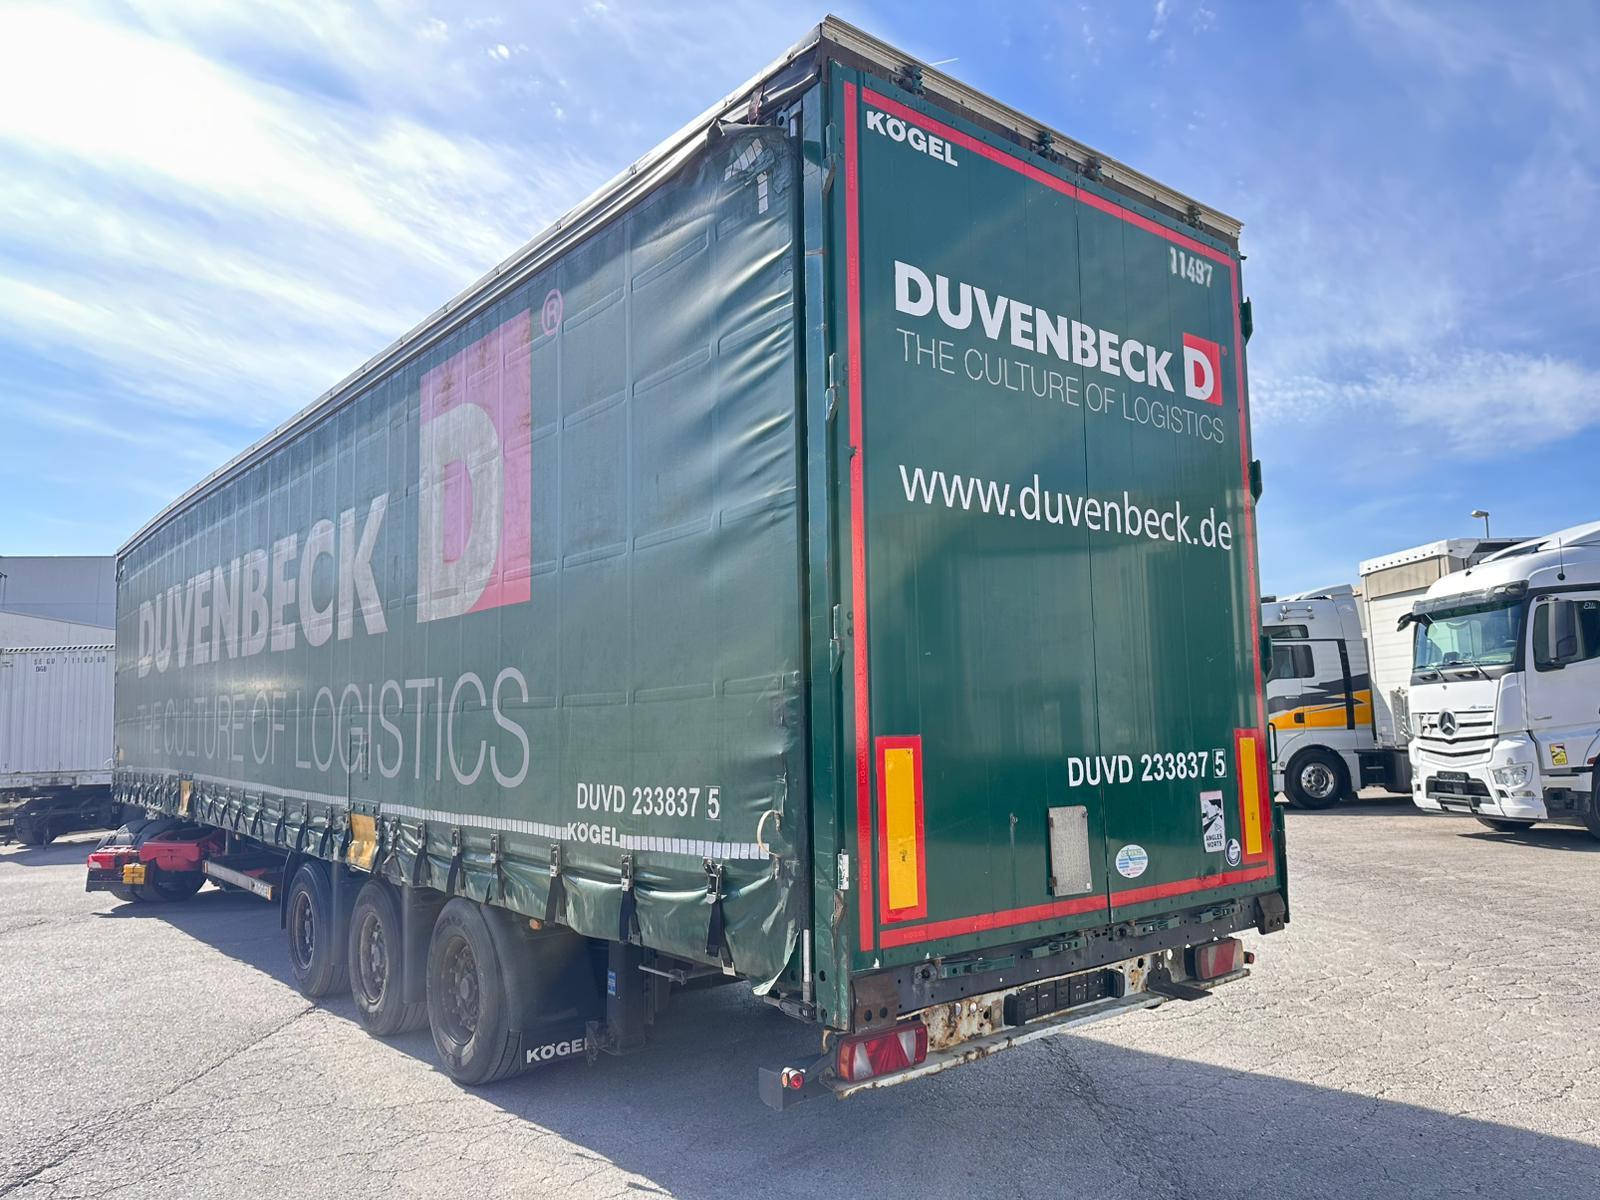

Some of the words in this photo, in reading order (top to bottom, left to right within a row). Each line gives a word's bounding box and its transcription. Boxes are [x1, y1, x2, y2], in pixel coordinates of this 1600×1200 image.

[866, 110, 958, 167] KÖGEL
[894, 260, 1175, 393] DUVENBECK
[896, 328, 956, 375] THE
[964, 348, 1080, 407] CULTURE
[1086, 383, 1116, 414] OF
[1122, 392, 1225, 444] LOGISTICS
[898, 464, 1233, 551] www.duvenbeck.de
[138, 491, 389, 679] DUVENBECK
[164, 693, 246, 761] CULTURE
[251, 689, 287, 765] OF
[295, 666, 530, 788] LOGISTICS
[1067, 755, 1134, 788] DUVD
[1140, 751, 1209, 782] 233837
[1213, 750, 1226, 777] 5
[566, 821, 621, 847] KÖGEL
[576, 783, 626, 813] DUVD
[632, 786, 700, 817] 233837
[707, 788, 720, 819] 5
